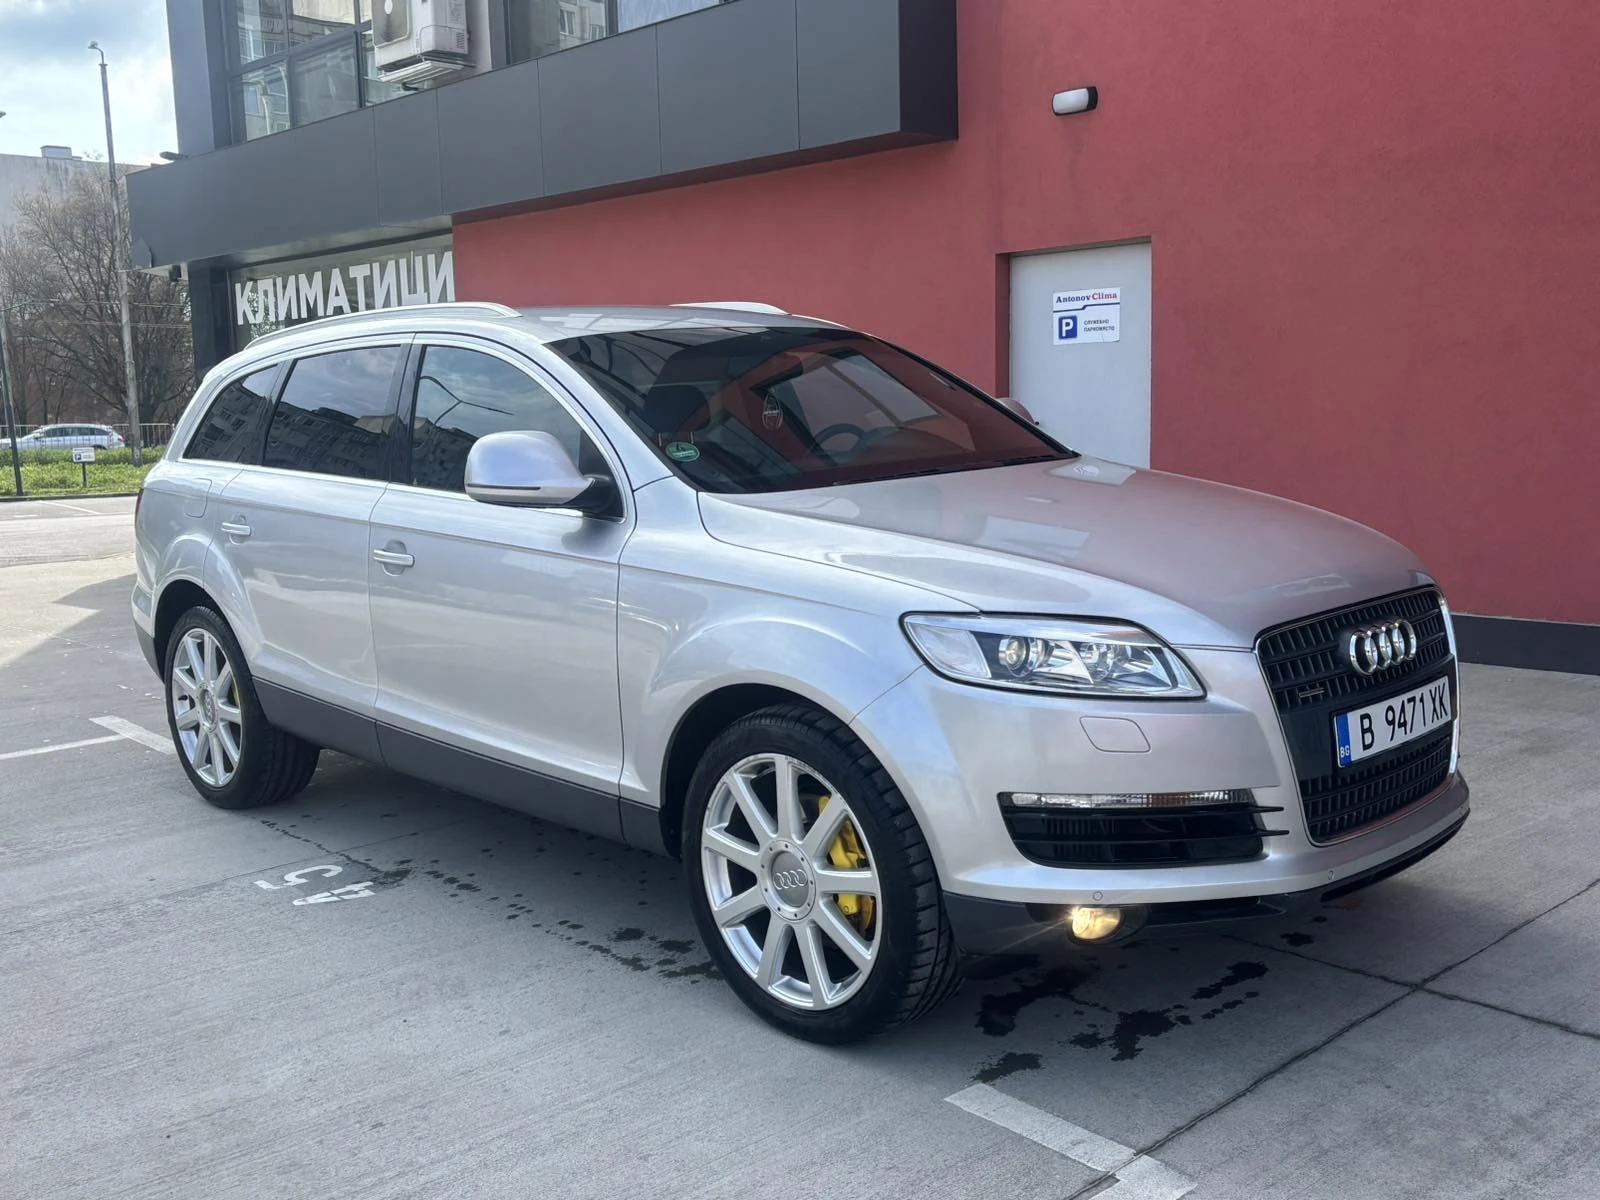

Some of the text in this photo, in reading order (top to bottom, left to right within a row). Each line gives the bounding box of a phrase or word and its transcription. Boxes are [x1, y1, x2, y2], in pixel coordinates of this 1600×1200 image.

[235, 251, 456, 325] КЛИМАТИЦИ
[1056, 292, 1118, 303] Antonov Clima
[1062, 318, 1074, 337] P
[1360, 682, 1449, 752] B 9471 XK
[1340, 745, 1350, 758] BG
